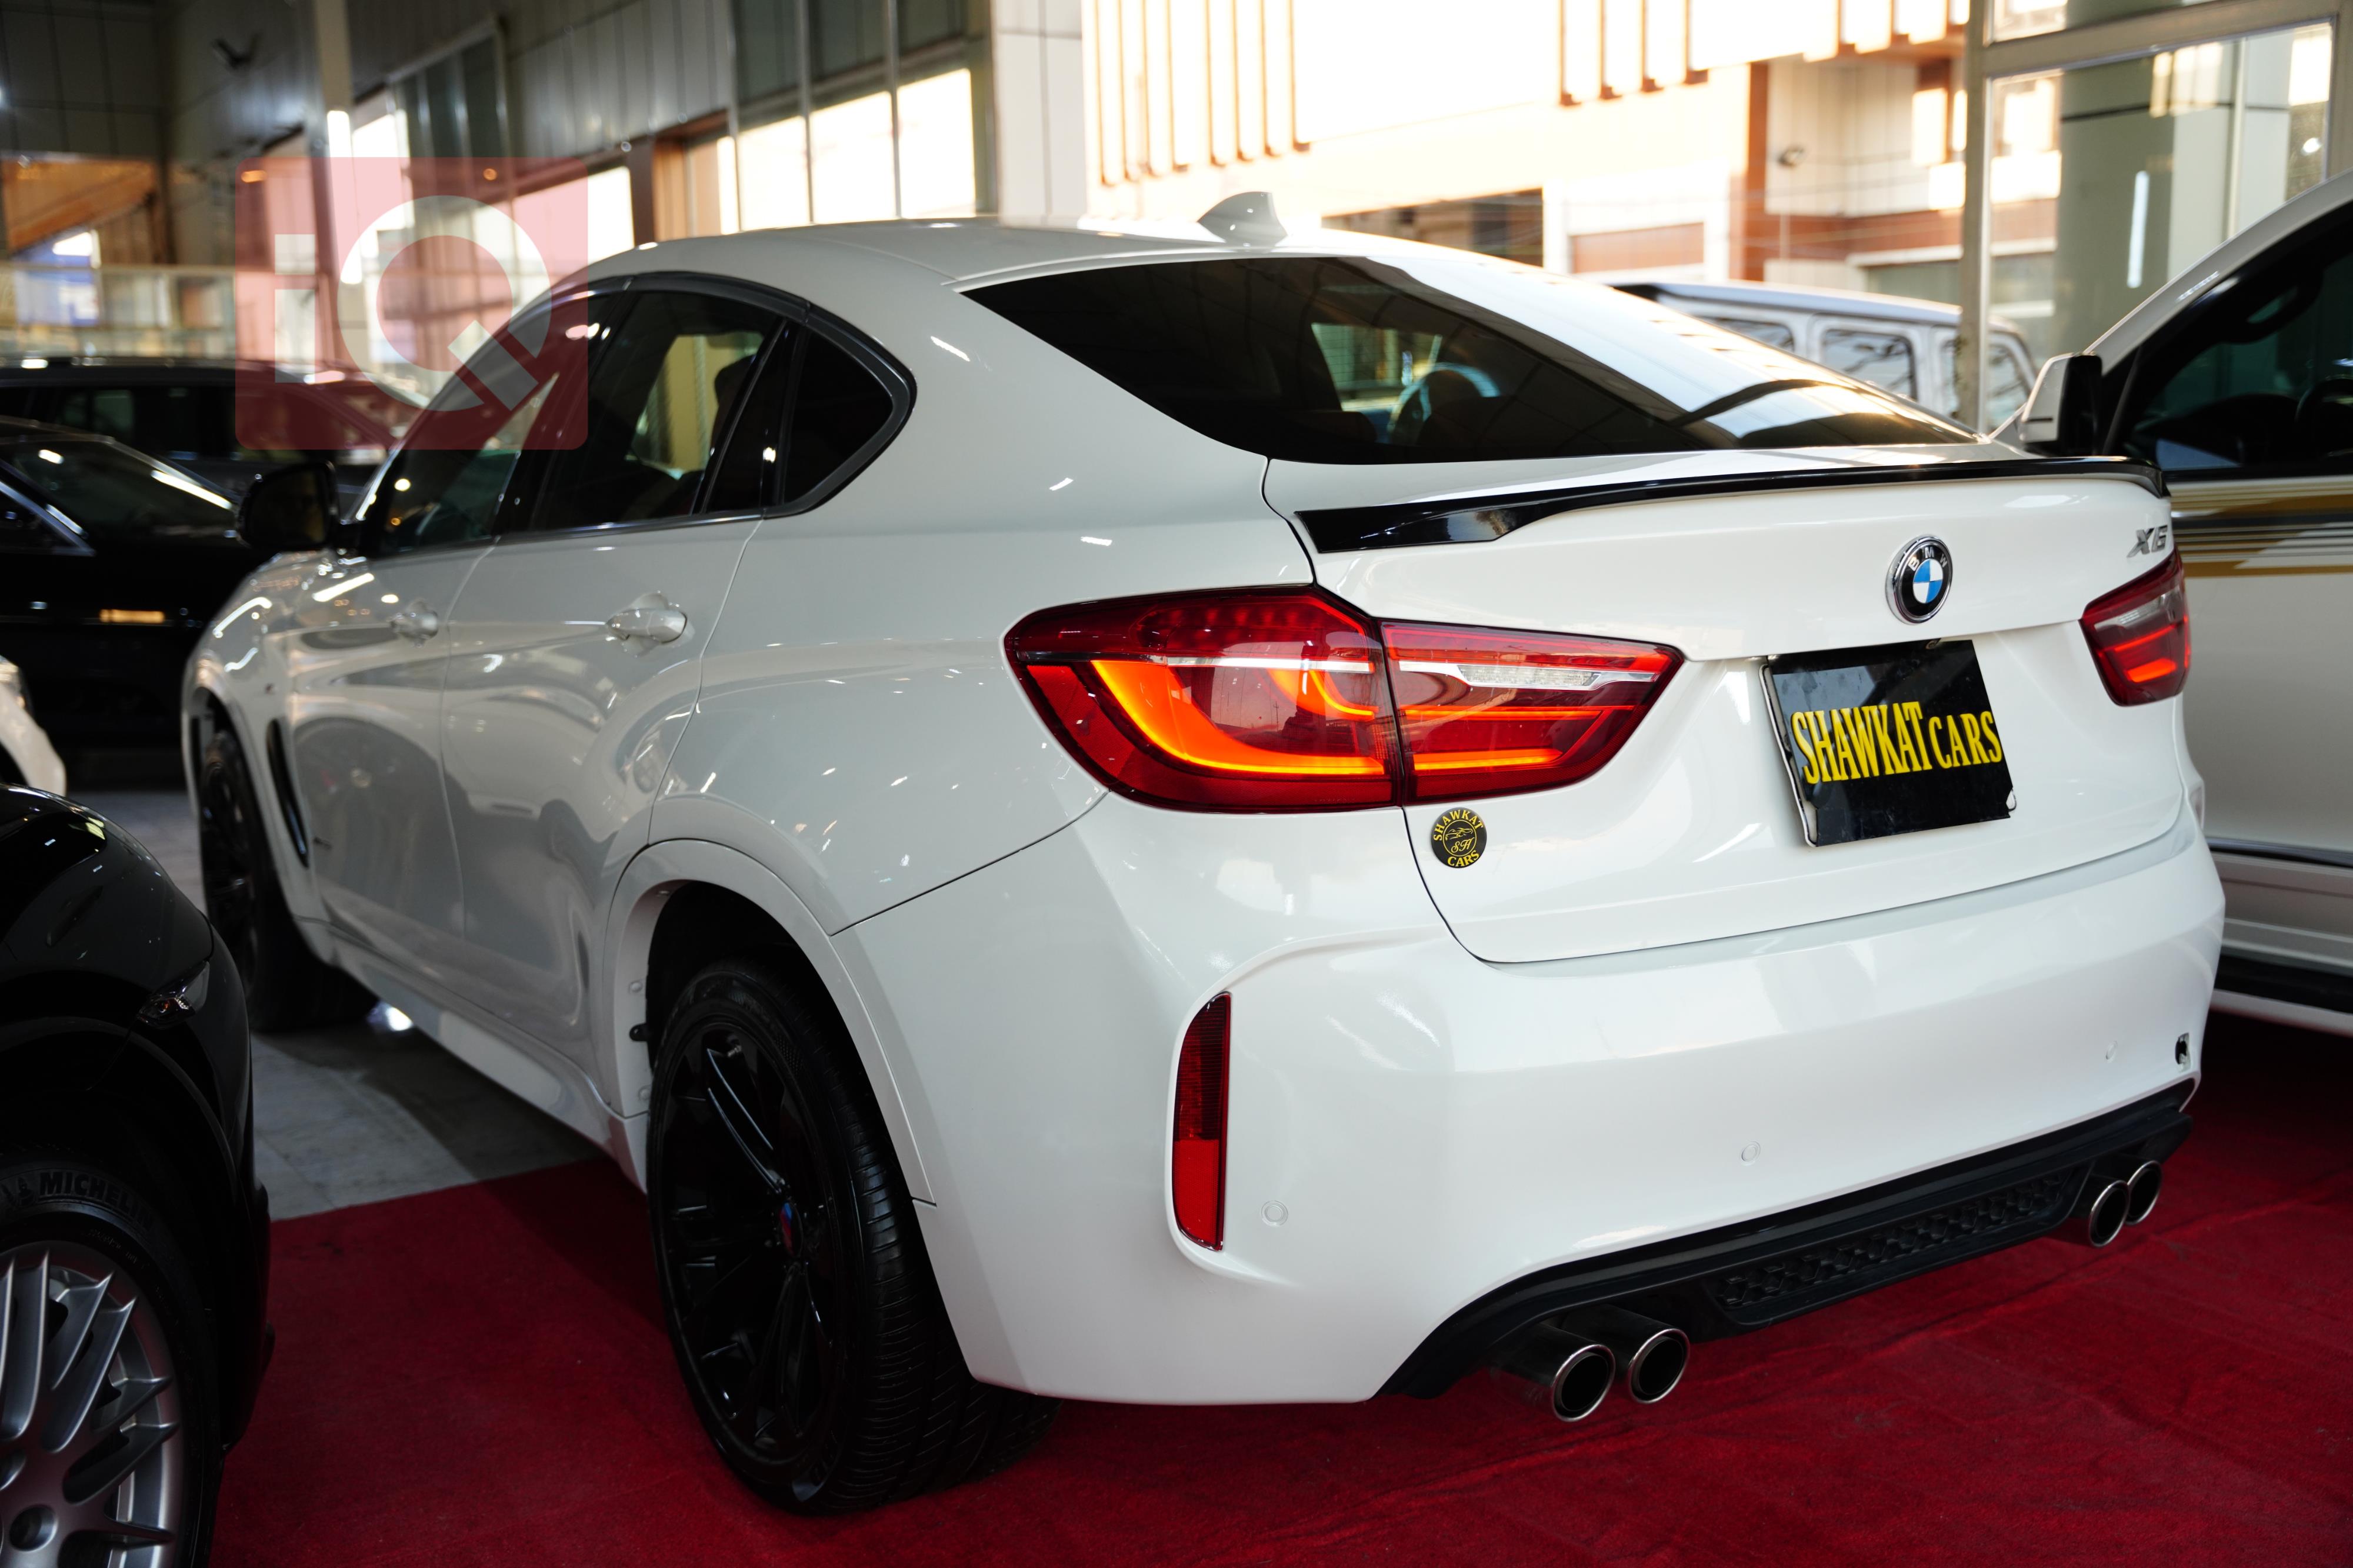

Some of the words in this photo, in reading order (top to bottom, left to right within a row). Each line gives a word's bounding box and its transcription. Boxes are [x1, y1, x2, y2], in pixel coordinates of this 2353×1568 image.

[2126, 525, 2168, 558] X6
[1908, 546, 1948, 571] BMW
[1791, 700, 1934, 784] SHAWKAT
[1928, 710, 2002, 769] CARS
[1433, 809, 1484, 841] SHAWKAT
[1447, 850, 1480, 867] CARS
[39, 1172, 154, 1229] MICHELIN
